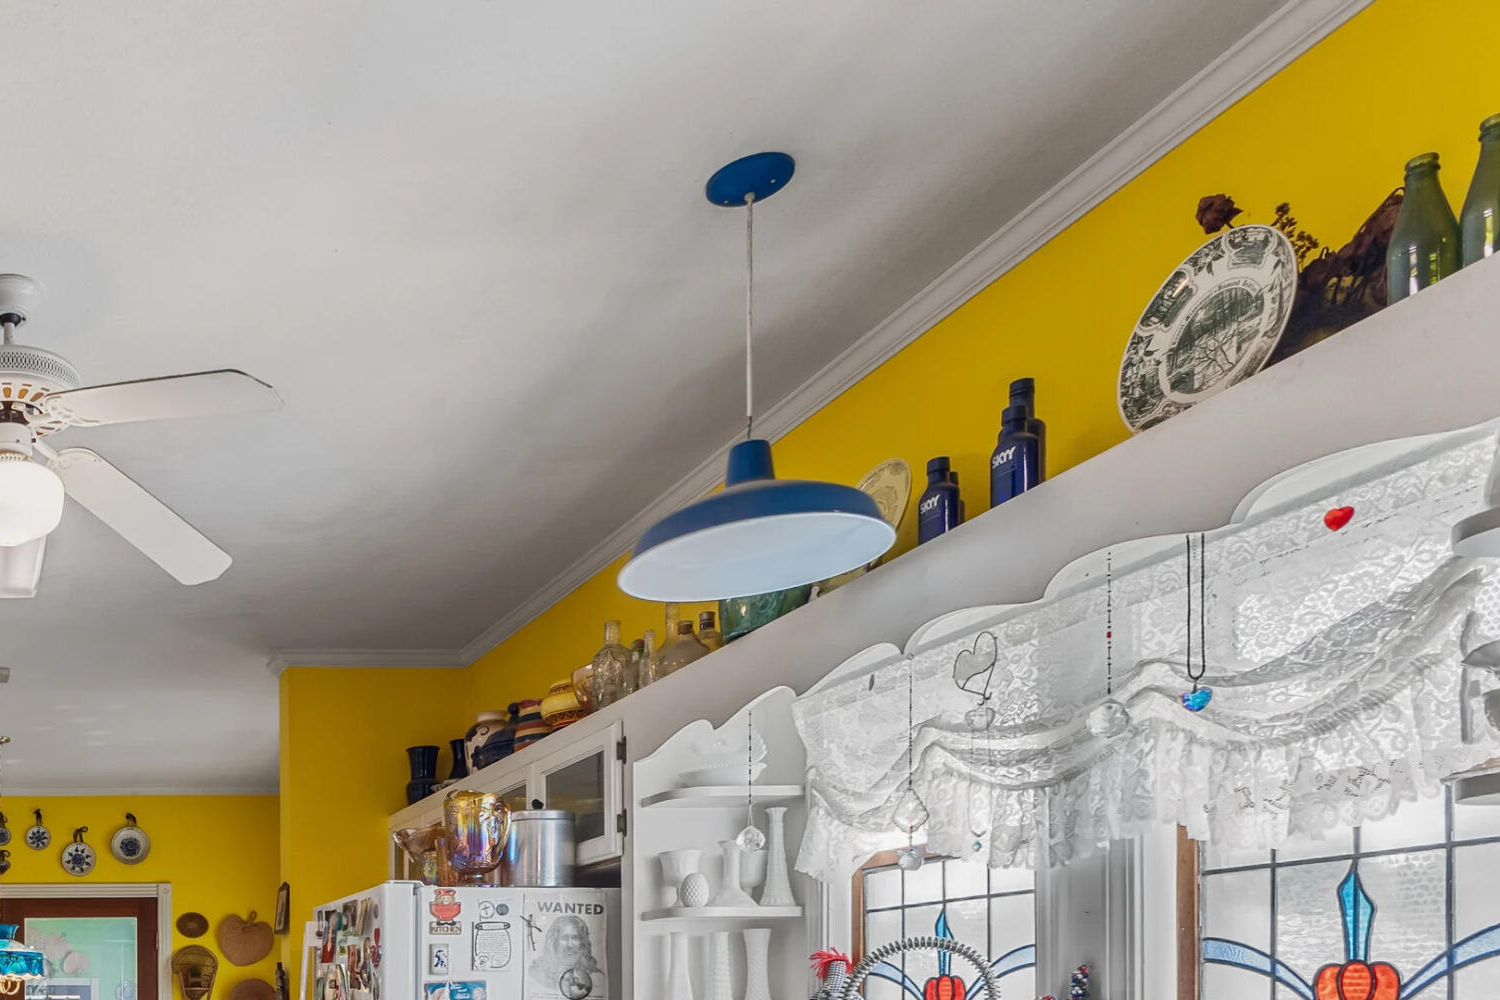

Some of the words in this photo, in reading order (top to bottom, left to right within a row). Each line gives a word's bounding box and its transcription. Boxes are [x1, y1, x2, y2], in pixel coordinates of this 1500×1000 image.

[992, 446, 1016, 469] SKYY
[920, 494, 940, 513] SKYY
[537, 902, 604, 915] WANTED
